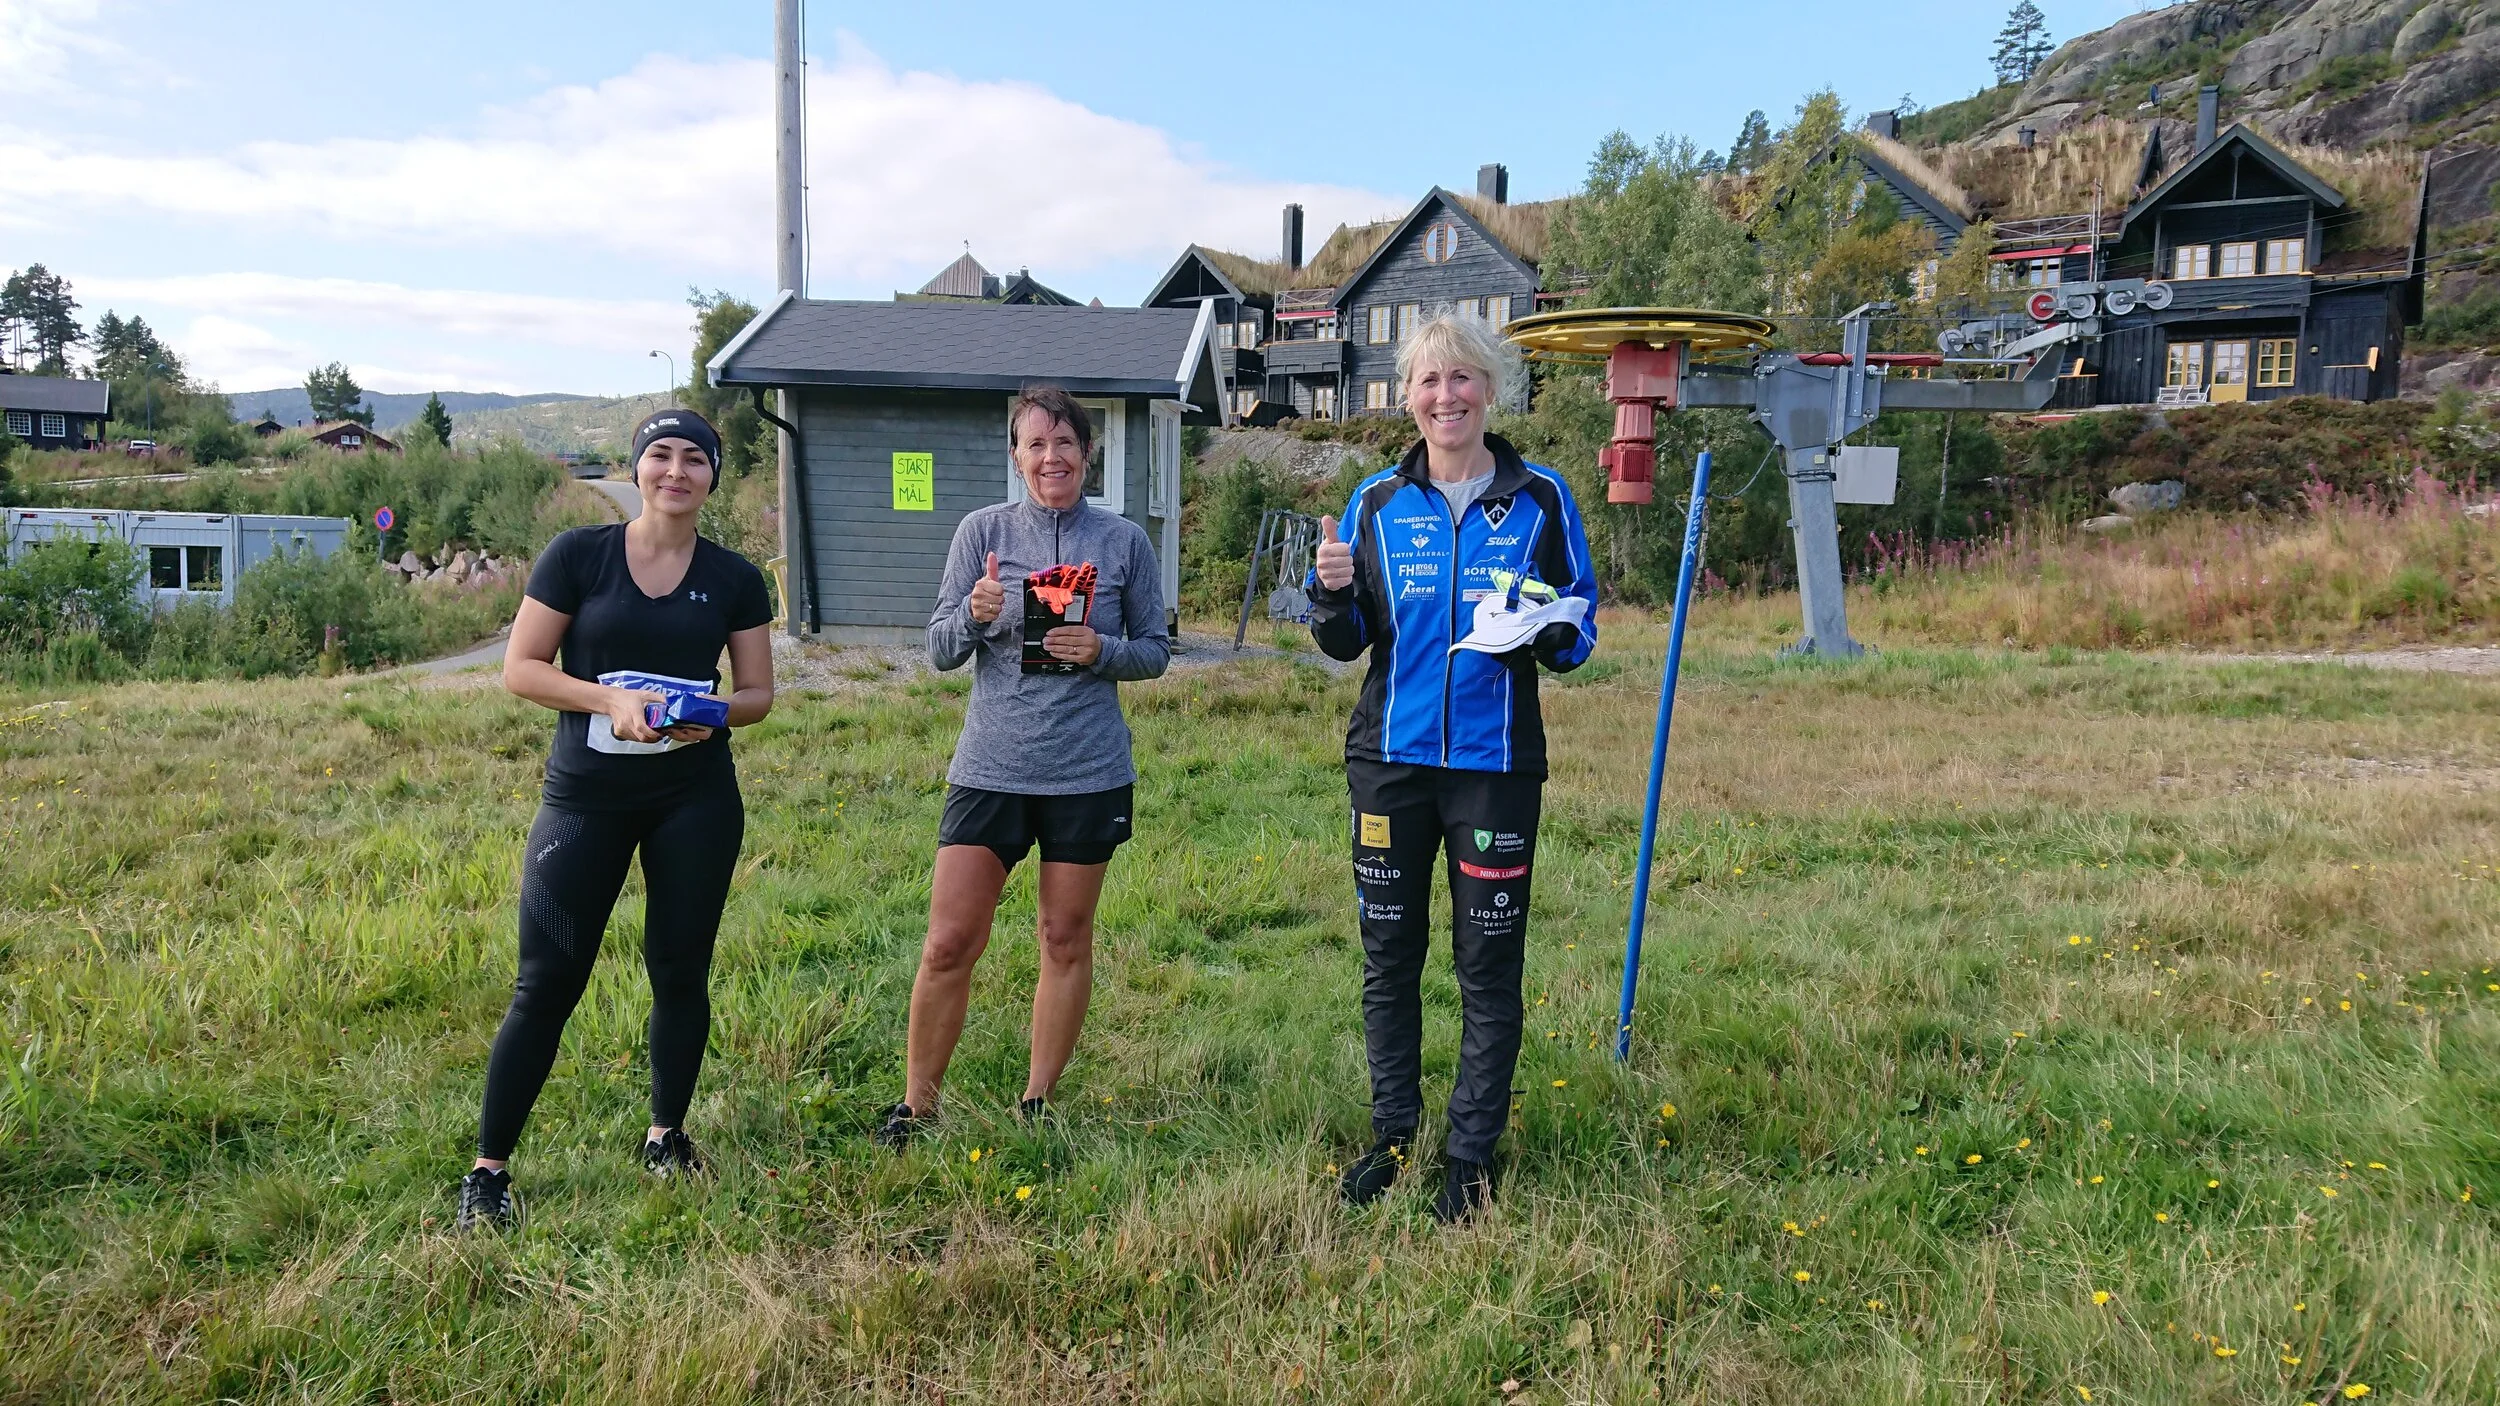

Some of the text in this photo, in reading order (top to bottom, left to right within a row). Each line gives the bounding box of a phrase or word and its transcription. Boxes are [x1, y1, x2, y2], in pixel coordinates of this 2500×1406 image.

[895, 458, 932, 475] START
[899, 484, 927, 502] MÅL
[1393, 515, 1443, 524] SPAREBANKEN
[1411, 522, 1426, 530] SØR
[1398, 564, 1415, 577] FH
[1495, 831, 1519, 840] ÅSERAL
[1480, 869, 1501, 879] NINA
